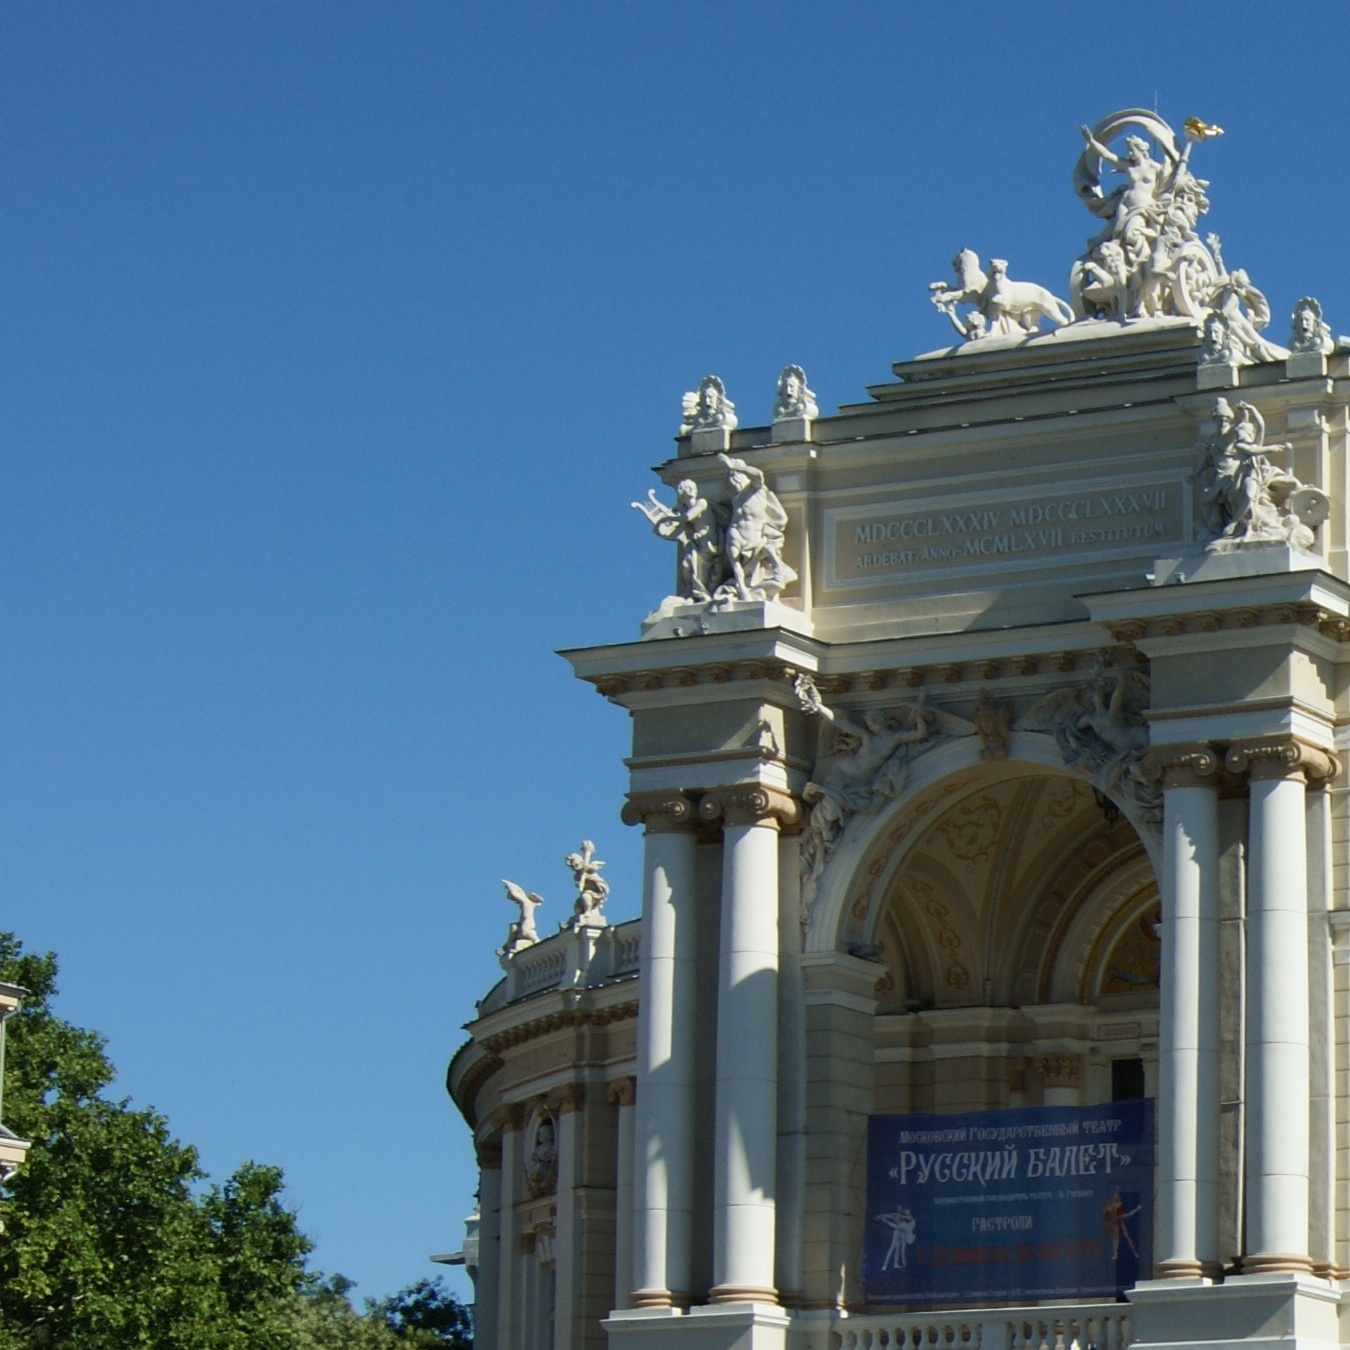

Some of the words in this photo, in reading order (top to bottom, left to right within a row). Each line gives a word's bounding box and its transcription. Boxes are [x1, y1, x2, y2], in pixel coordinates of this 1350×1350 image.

[855, 510, 1000, 545] MDCCCLXXXIV
[1009, 490, 1166, 527] MDCCCLXXXVII
[1070, 524, 1165, 545] RESTITUTUM
[1081, 1119, 1122, 1134] ТЕАТР
[889, 1143, 1018, 1187] «РУССКИЙ
[1027, 1142, 1132, 1178] БАЛЕТ»
[971, 1215, 1034, 1232] ГАСТРОЛИ
